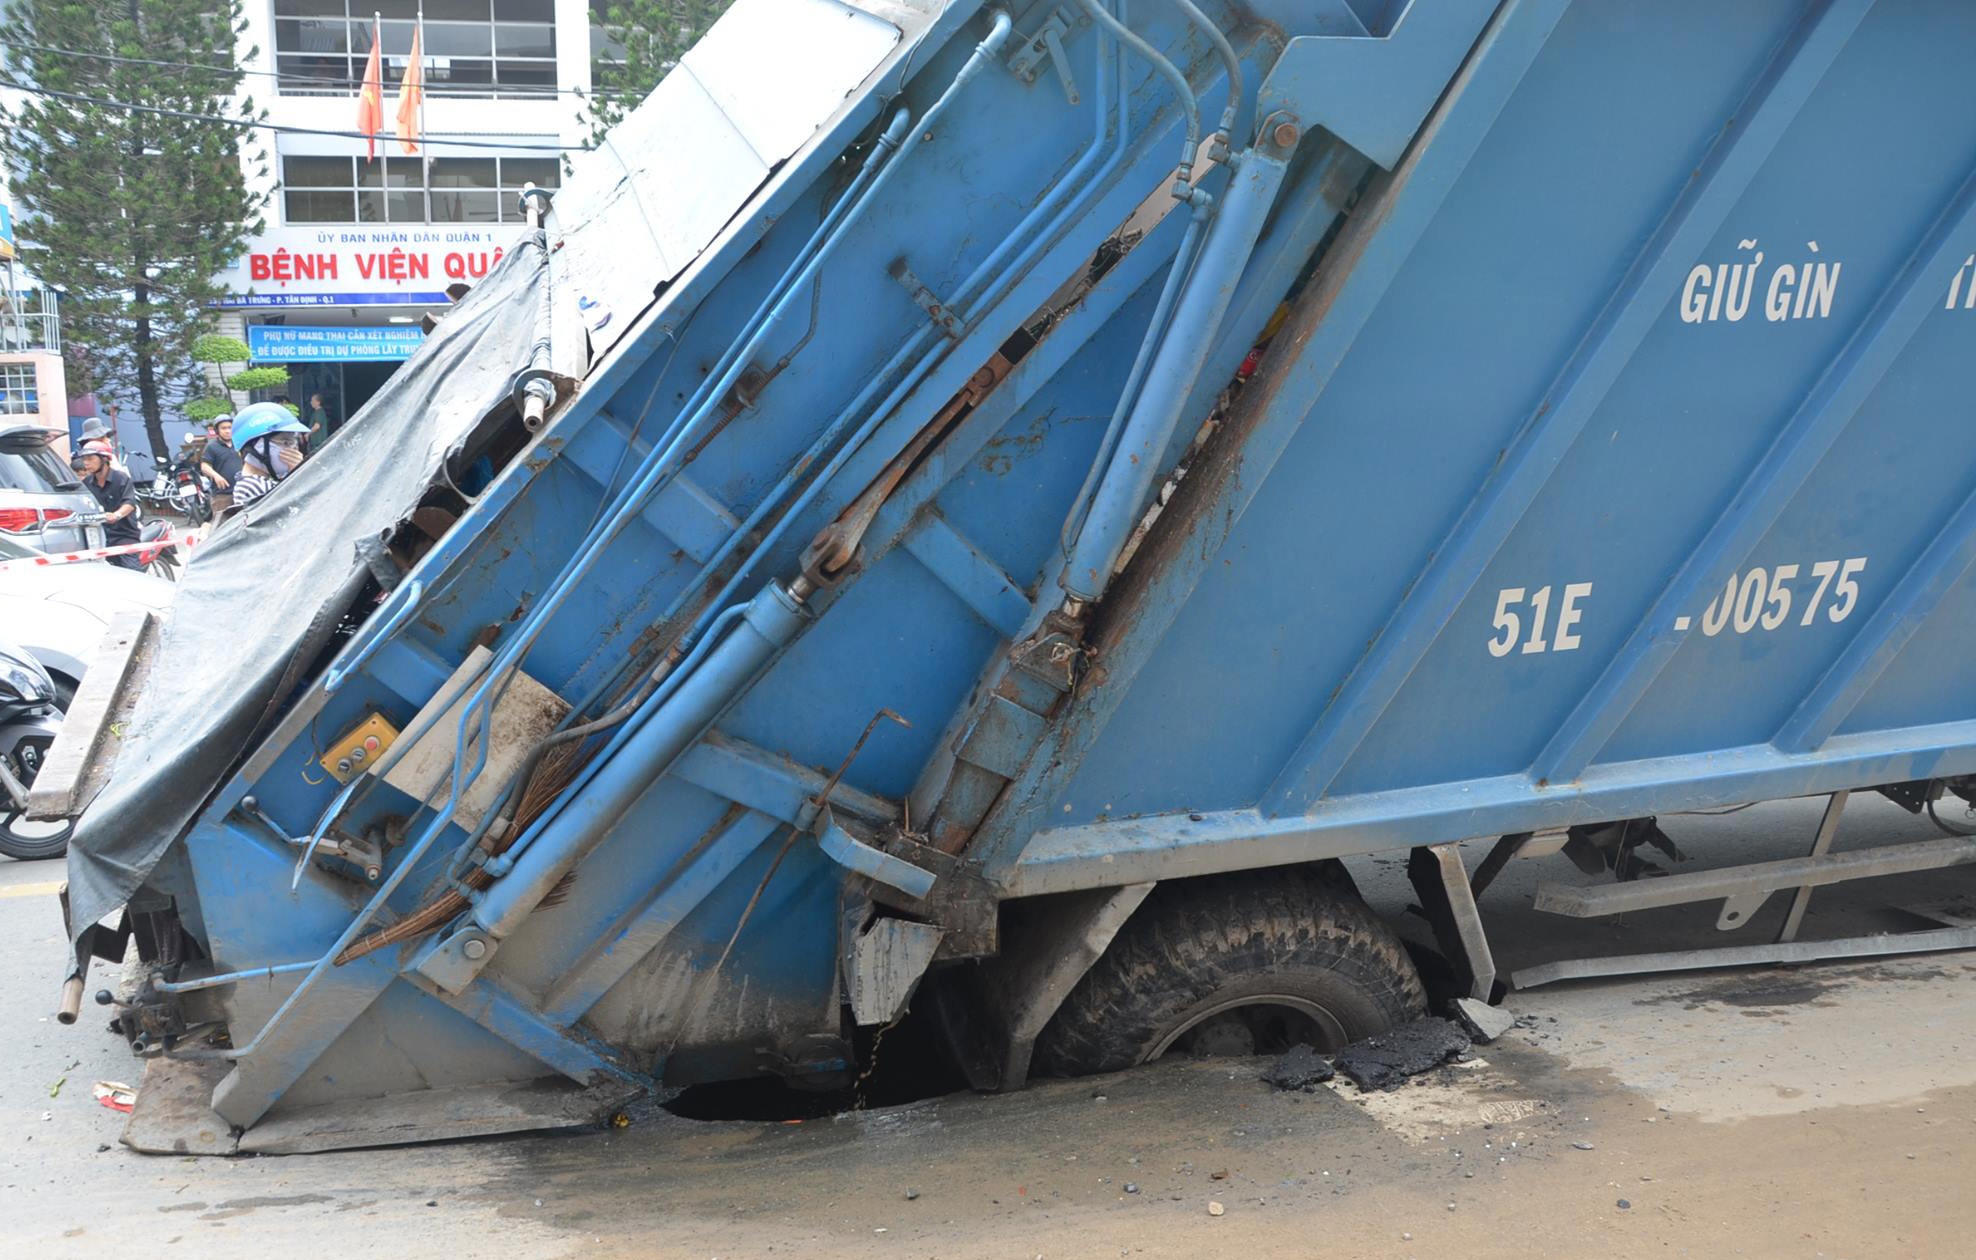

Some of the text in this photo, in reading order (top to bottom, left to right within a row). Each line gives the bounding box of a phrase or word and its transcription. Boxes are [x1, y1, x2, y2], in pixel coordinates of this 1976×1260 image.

[341, 233, 366, 243] BAN
[250, 247, 338, 288] BỆNH
[354, 247, 429, 285] VIỆN
[1680, 239, 1842, 324] GIỮ GÌN
[298, 331, 323, 341] MANG
[327, 331, 345, 341] THAI
[1488, 581, 1593, 658] 51E
